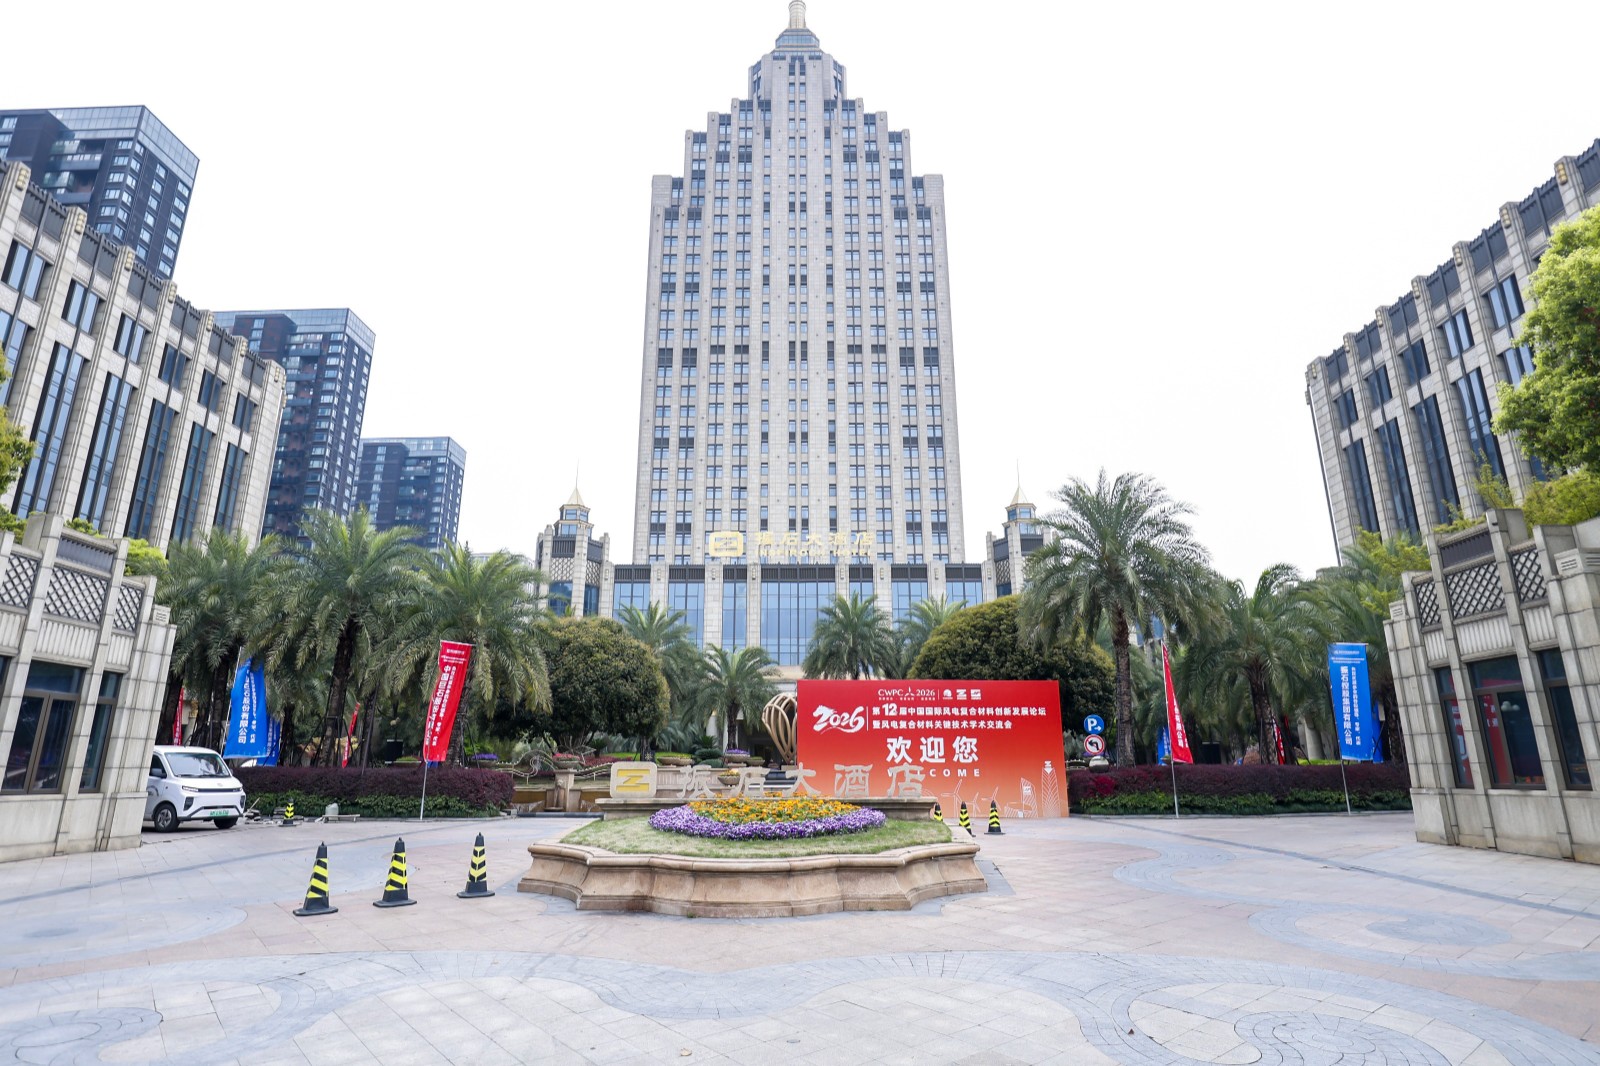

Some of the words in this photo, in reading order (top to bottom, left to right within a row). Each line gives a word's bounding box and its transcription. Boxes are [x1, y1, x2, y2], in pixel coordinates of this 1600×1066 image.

[877, 688, 904, 697] CWPC
[916, 688, 936, 697] 2026
[1087, 718, 1097, 731] P
[886, 736, 979, 764] 欢迎您
[676, 762, 926, 799] 振石大酒店
